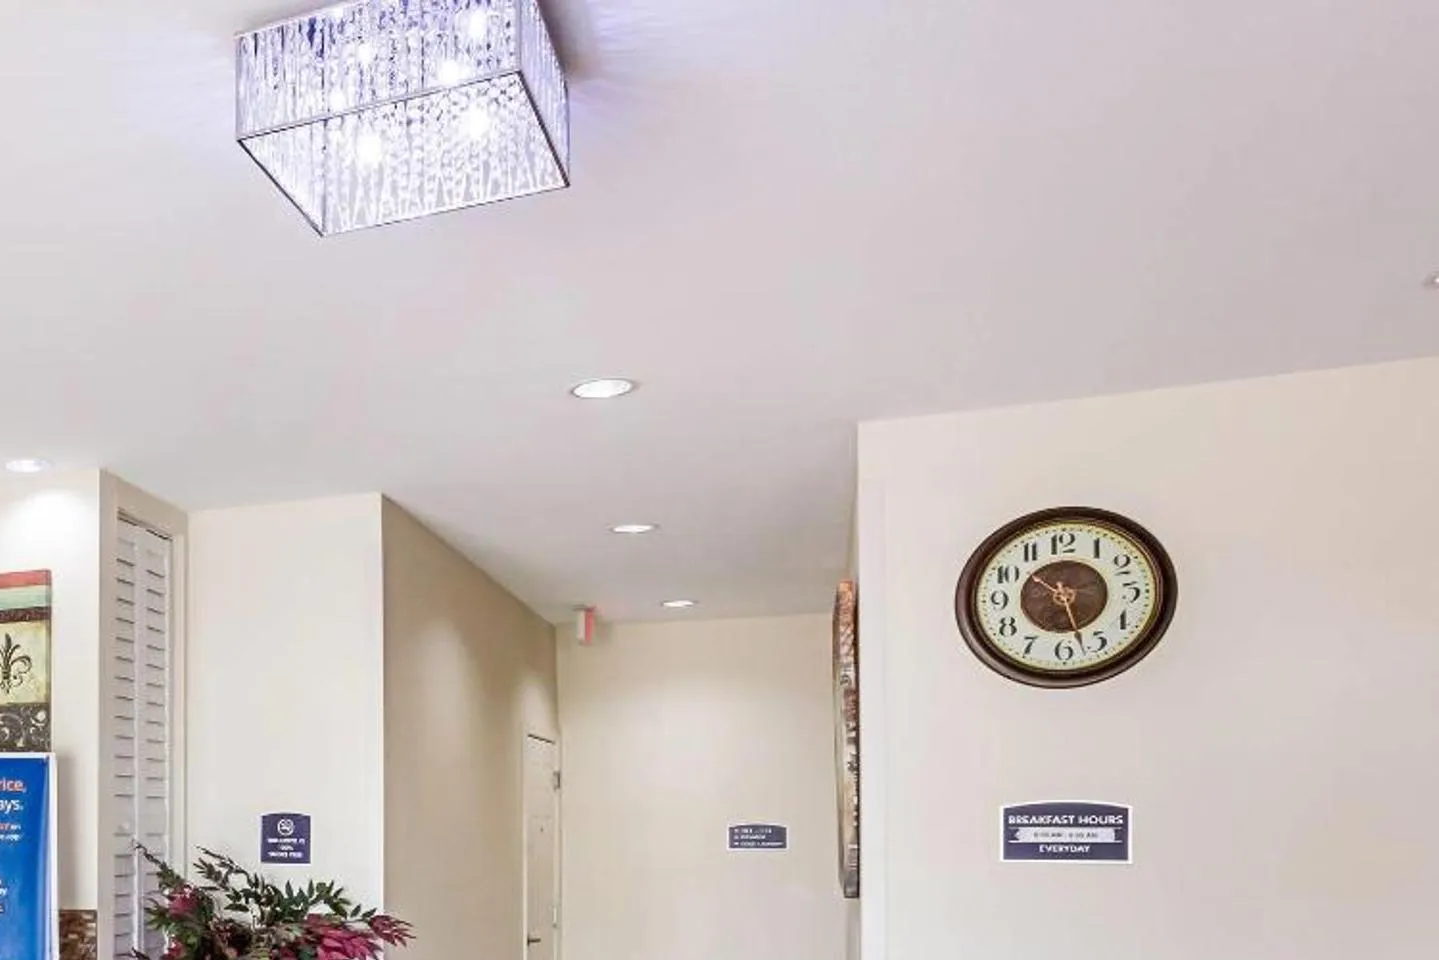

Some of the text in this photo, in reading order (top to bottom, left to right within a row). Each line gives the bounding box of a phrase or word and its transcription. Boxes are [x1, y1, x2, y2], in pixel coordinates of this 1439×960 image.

[1023, 541, 1038, 562] 11
[1050, 533, 1076, 555] 12
[1093, 537, 1101, 559] 1
[996, 565, 1020, 584] 10
[1113, 554, 1131, 576] 2
[990, 590, 1009, 610] 9
[1122, 580, 1141, 603] 3
[998, 617, 1017, 636] 8
[1023, 636, 1038, 655] 7
[1054, 639, 1073, 661] 6
[1087, 631, 1107, 652] 5
[1008, 815, 1124, 825] BREAKFAST HOURS
[1039, 844, 1091, 853] EVERYDAY
